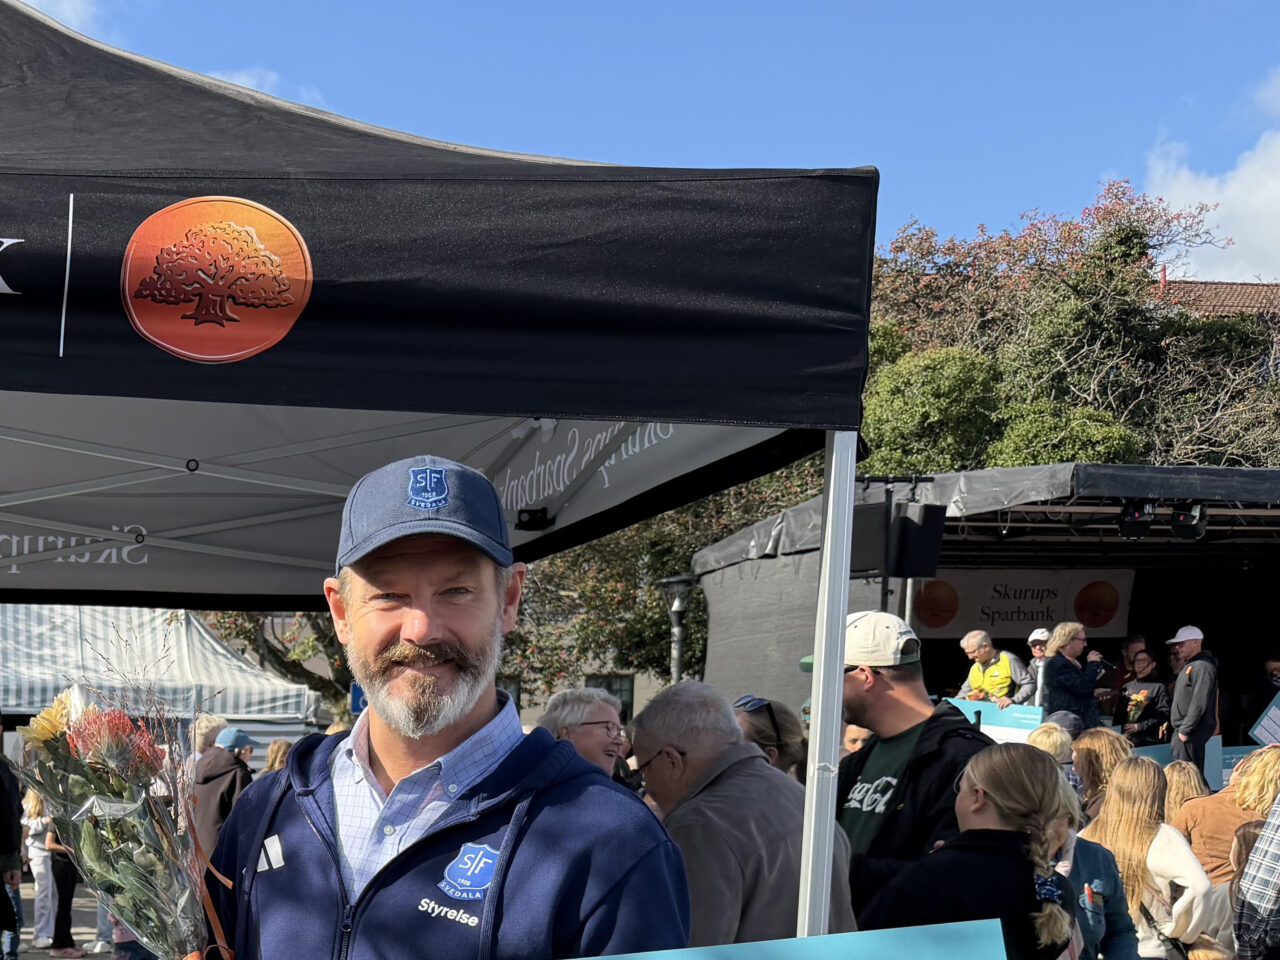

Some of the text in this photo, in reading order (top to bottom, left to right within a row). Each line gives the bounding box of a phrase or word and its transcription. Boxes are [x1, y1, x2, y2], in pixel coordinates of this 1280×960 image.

[991, 583, 1058, 604] Skurups
[979, 605, 1055, 626] Sparbank
[440, 881, 482, 899] SVEDALA
[418, 898, 479, 927] Styrelse
